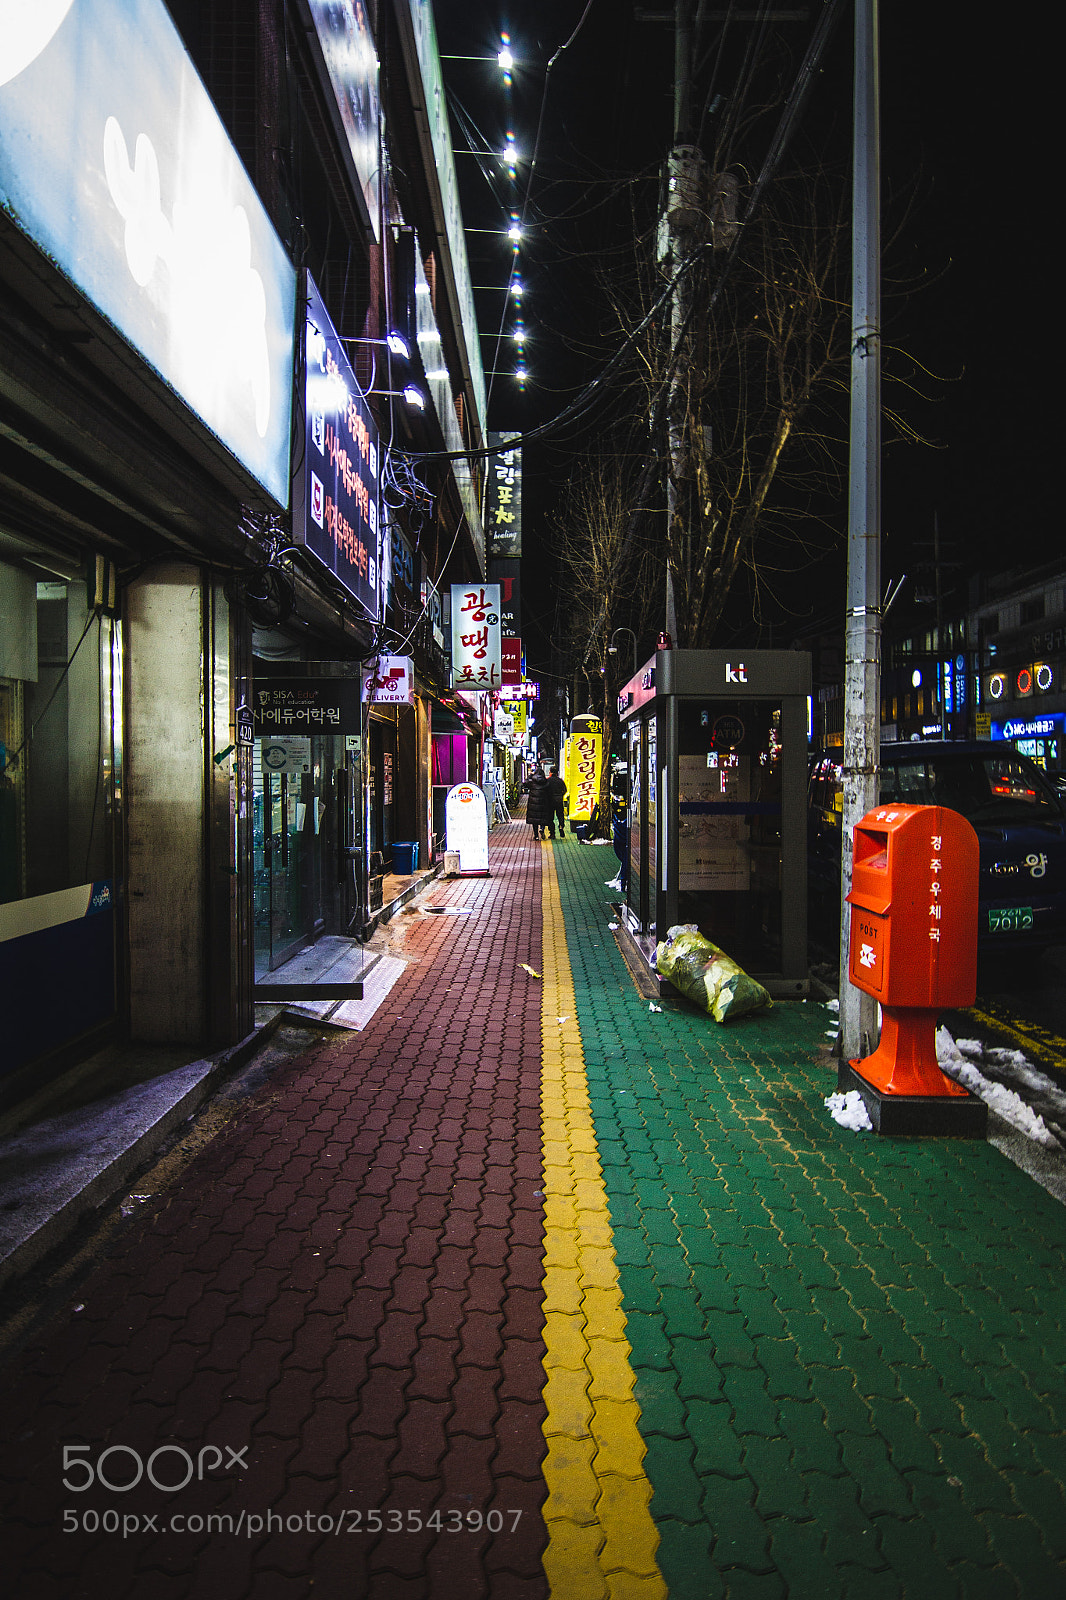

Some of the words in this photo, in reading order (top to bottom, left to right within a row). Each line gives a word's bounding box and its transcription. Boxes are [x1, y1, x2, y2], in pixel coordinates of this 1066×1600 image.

[493, 529, 517, 542] healing
[501, 612, 514, 620] AR
[456, 663, 499, 684] 포차
[725, 663, 748, 683] kt
[239, 725, 252, 741] 420
[575, 737, 597, 816] 힐링포차
[928, 836, 942, 942] 경주우체국
[860, 923, 878, 939] POST
[990, 915, 1032, 932] 7012
